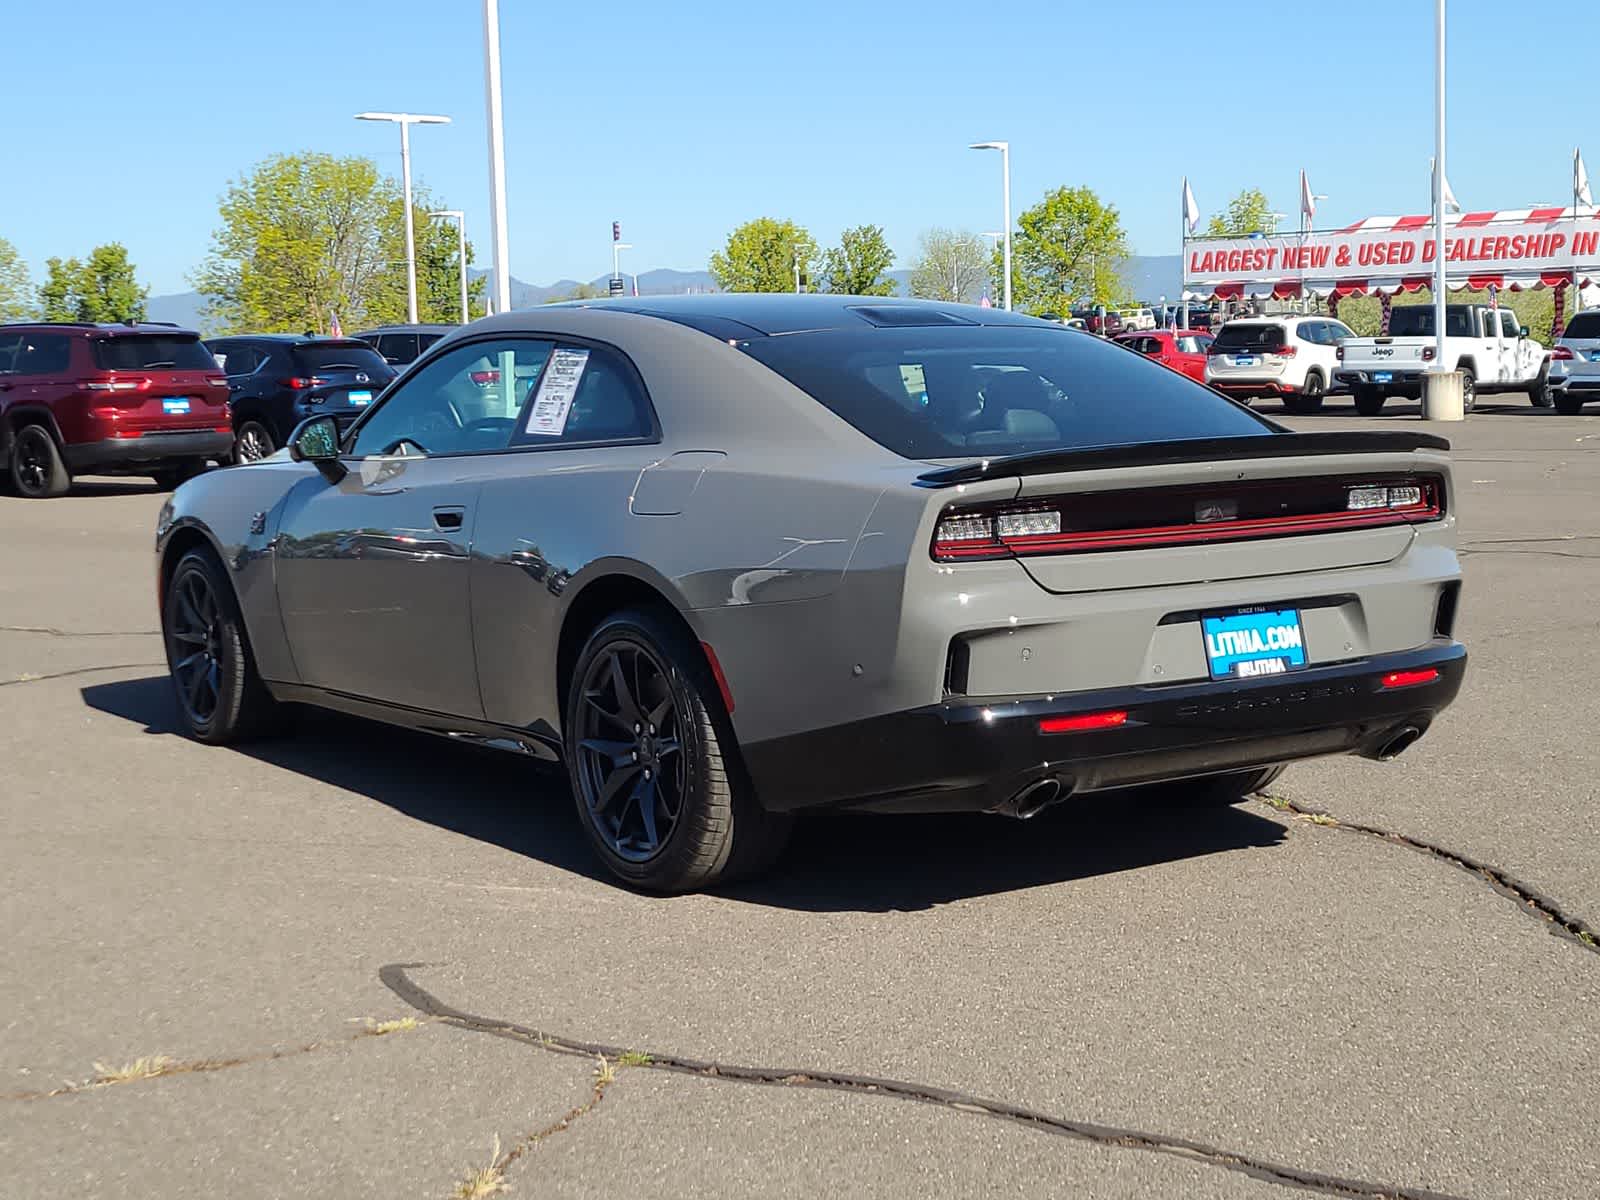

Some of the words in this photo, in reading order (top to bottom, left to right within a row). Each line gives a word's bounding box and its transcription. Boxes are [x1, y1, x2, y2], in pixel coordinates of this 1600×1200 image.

[1191, 248, 1279, 273] LARGEST
[1282, 245, 1331, 270] NEW
[1335, 244, 1351, 267] &
[1358, 240, 1416, 266] USED
[1571, 231, 1600, 256] IN
[1372, 347, 1394, 356] Jeep
[1207, 624, 1302, 658] LITHIA.COM
